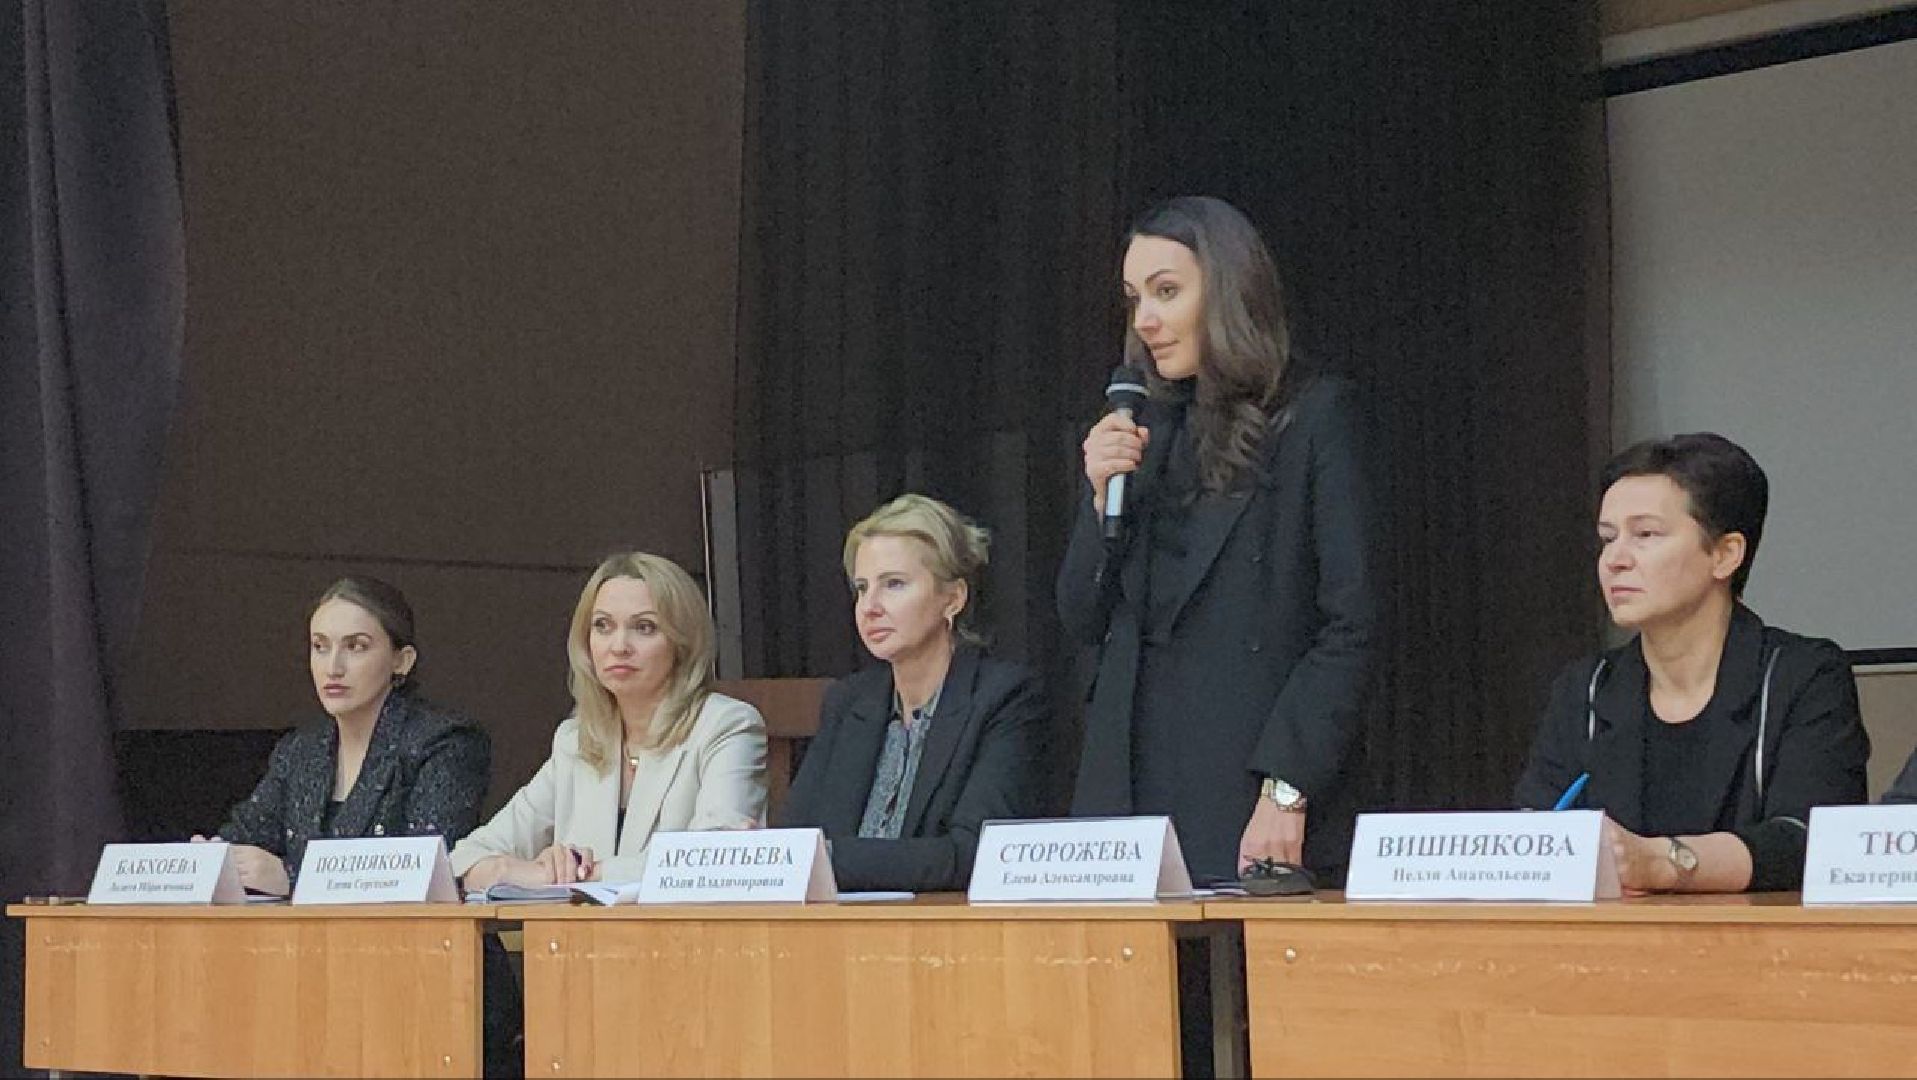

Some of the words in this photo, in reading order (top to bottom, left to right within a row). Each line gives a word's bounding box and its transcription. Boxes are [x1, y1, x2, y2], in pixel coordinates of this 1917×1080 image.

[1000, 840, 1142, 862] СТОРОЖЕВА
[1377, 834, 1575, 857] ВИШНЯКОВА
[316, 853, 422, 873] ПОЗДНЯКОВА
[658, 846, 793, 867] АРСЕНТЬЕВА
[116, 858, 198, 875] БАБХОЕВА
[1445, 868, 1552, 881] Анатольевна
[697, 875, 785, 891] Владимировна
[1002, 872, 1037, 885] Елена
[1042, 872, 1135, 887] Александровна
